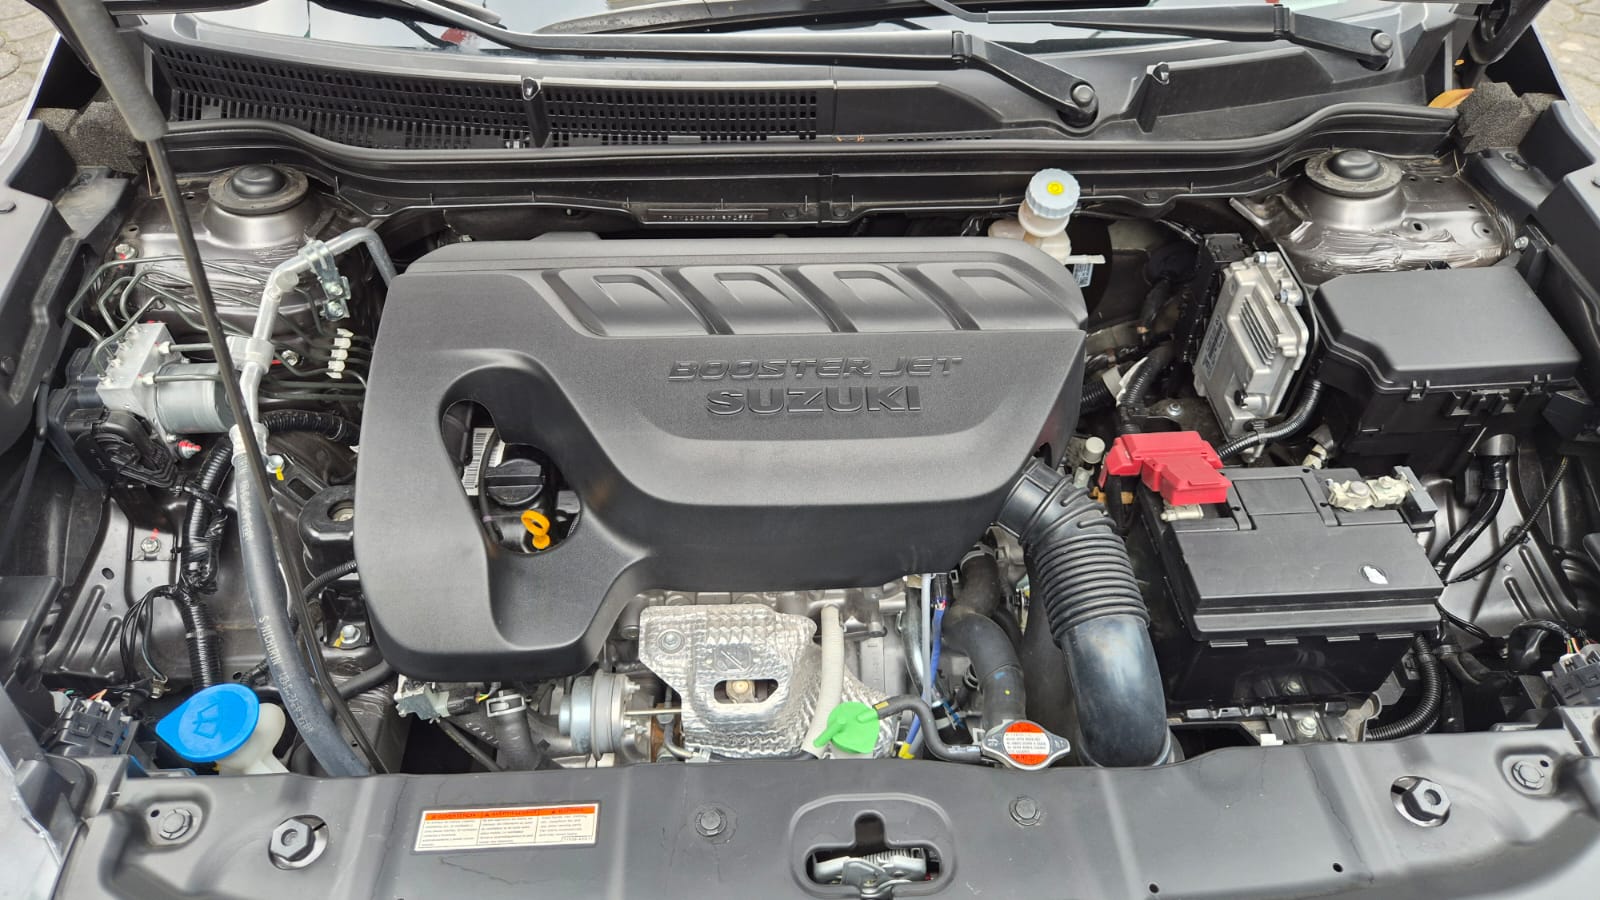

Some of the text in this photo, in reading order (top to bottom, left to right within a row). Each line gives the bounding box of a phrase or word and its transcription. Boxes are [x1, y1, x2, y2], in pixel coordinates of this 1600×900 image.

[667, 356, 964, 382] BOOSTER JET
[706, 385, 922, 415] SUZUKI
